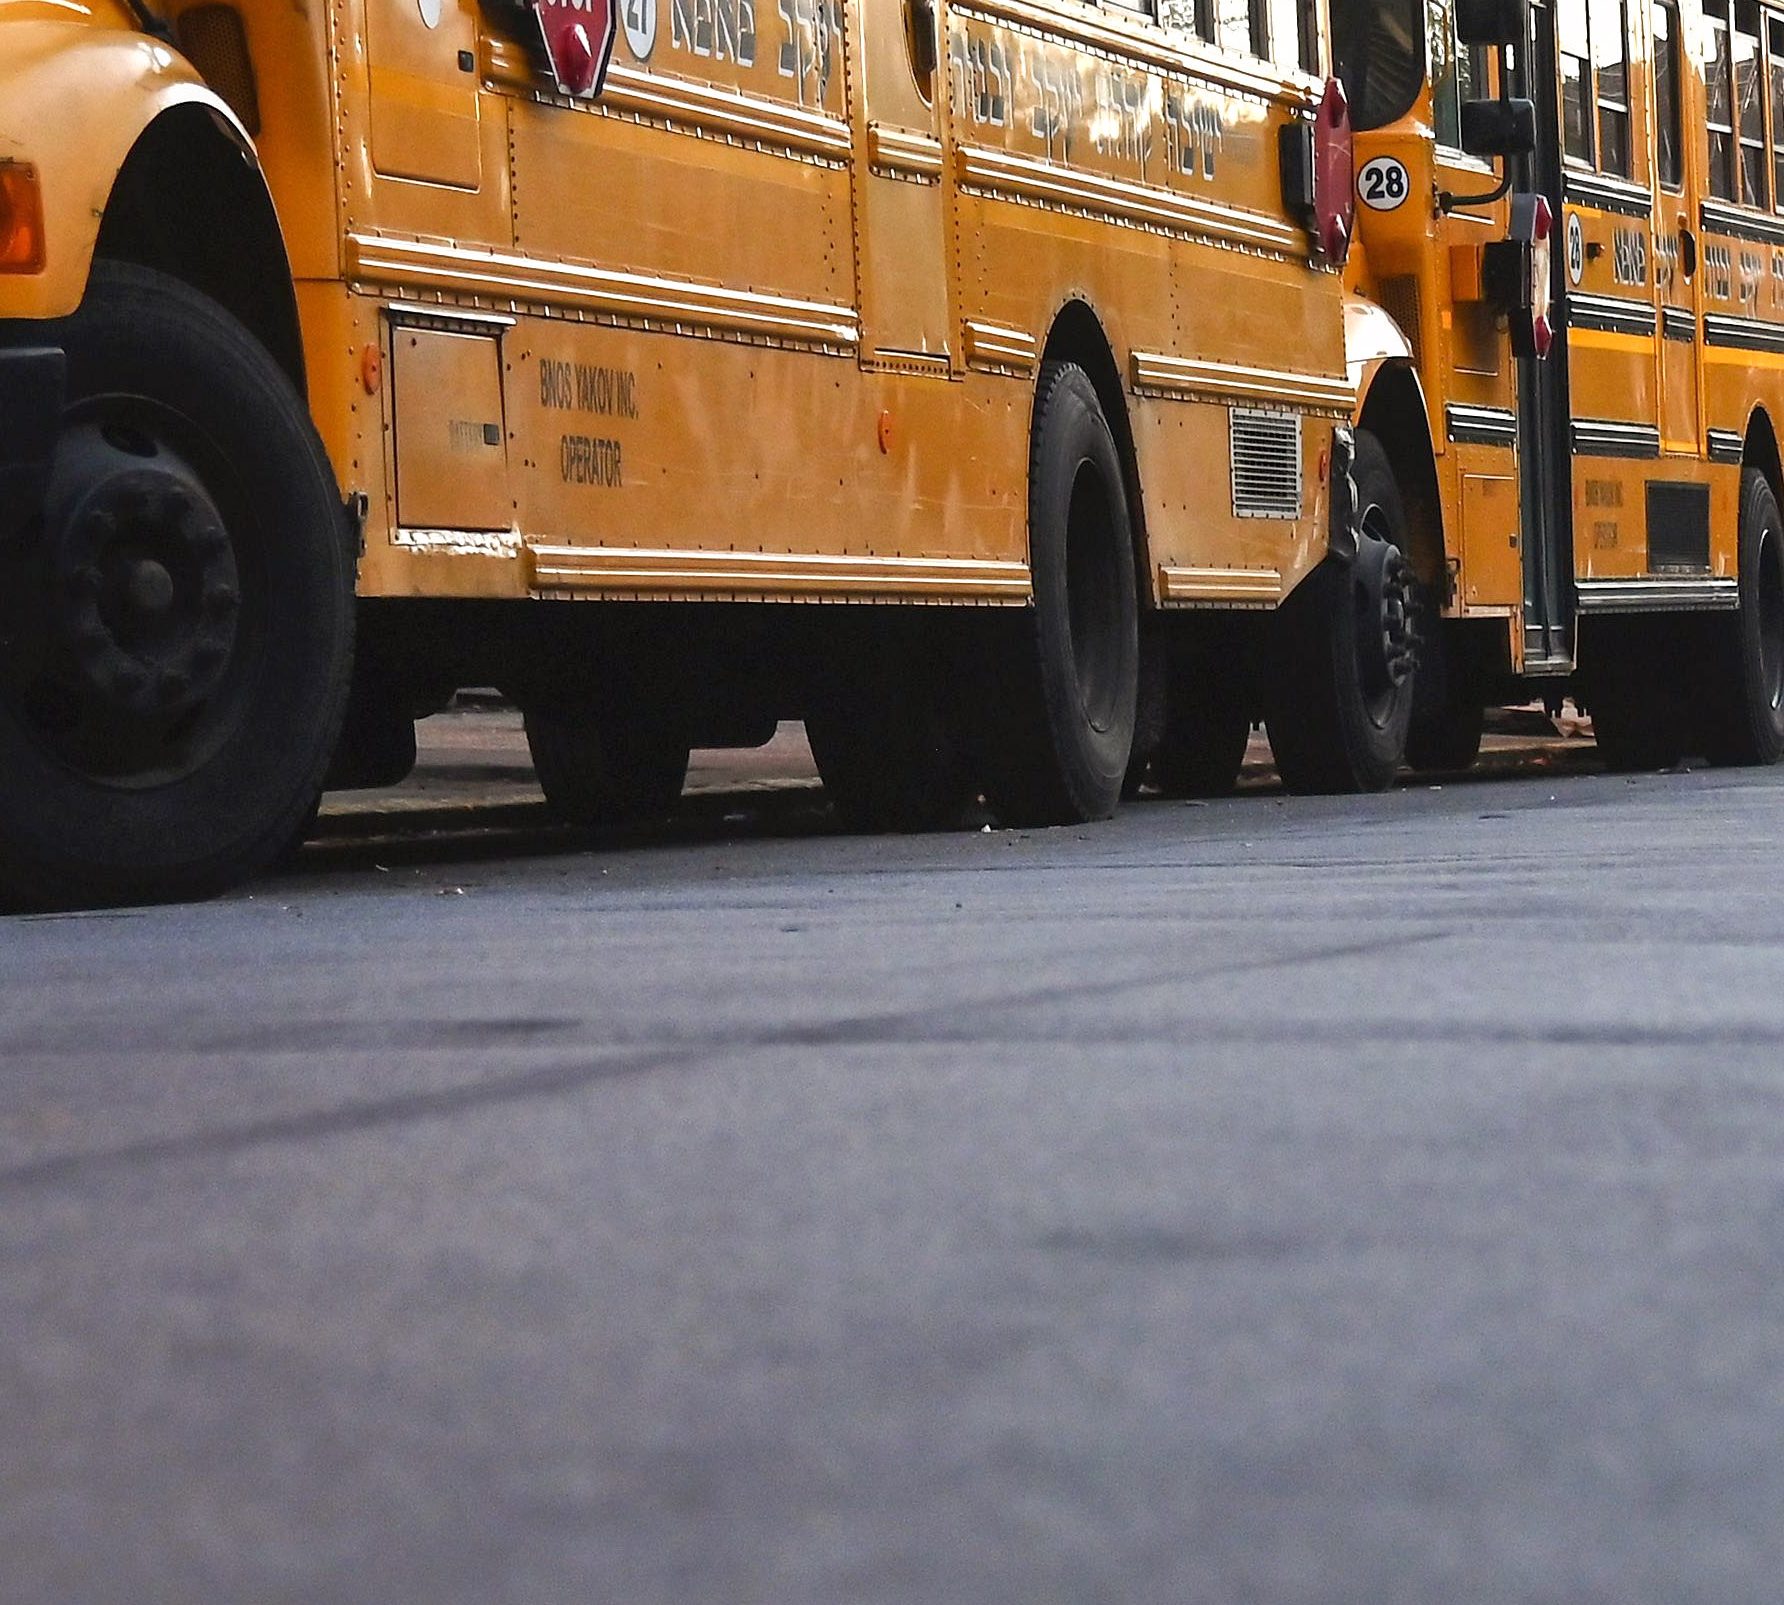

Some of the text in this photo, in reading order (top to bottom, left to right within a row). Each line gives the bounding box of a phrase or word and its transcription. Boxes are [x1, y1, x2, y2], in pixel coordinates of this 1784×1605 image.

[1365, 165, 1404, 200] 28
[1569, 225, 1581, 270] 28
[539, 357, 573, 410] BNOS
[574, 364, 614, 416] YAKOV
[560, 434, 623, 487] OPERATOR
